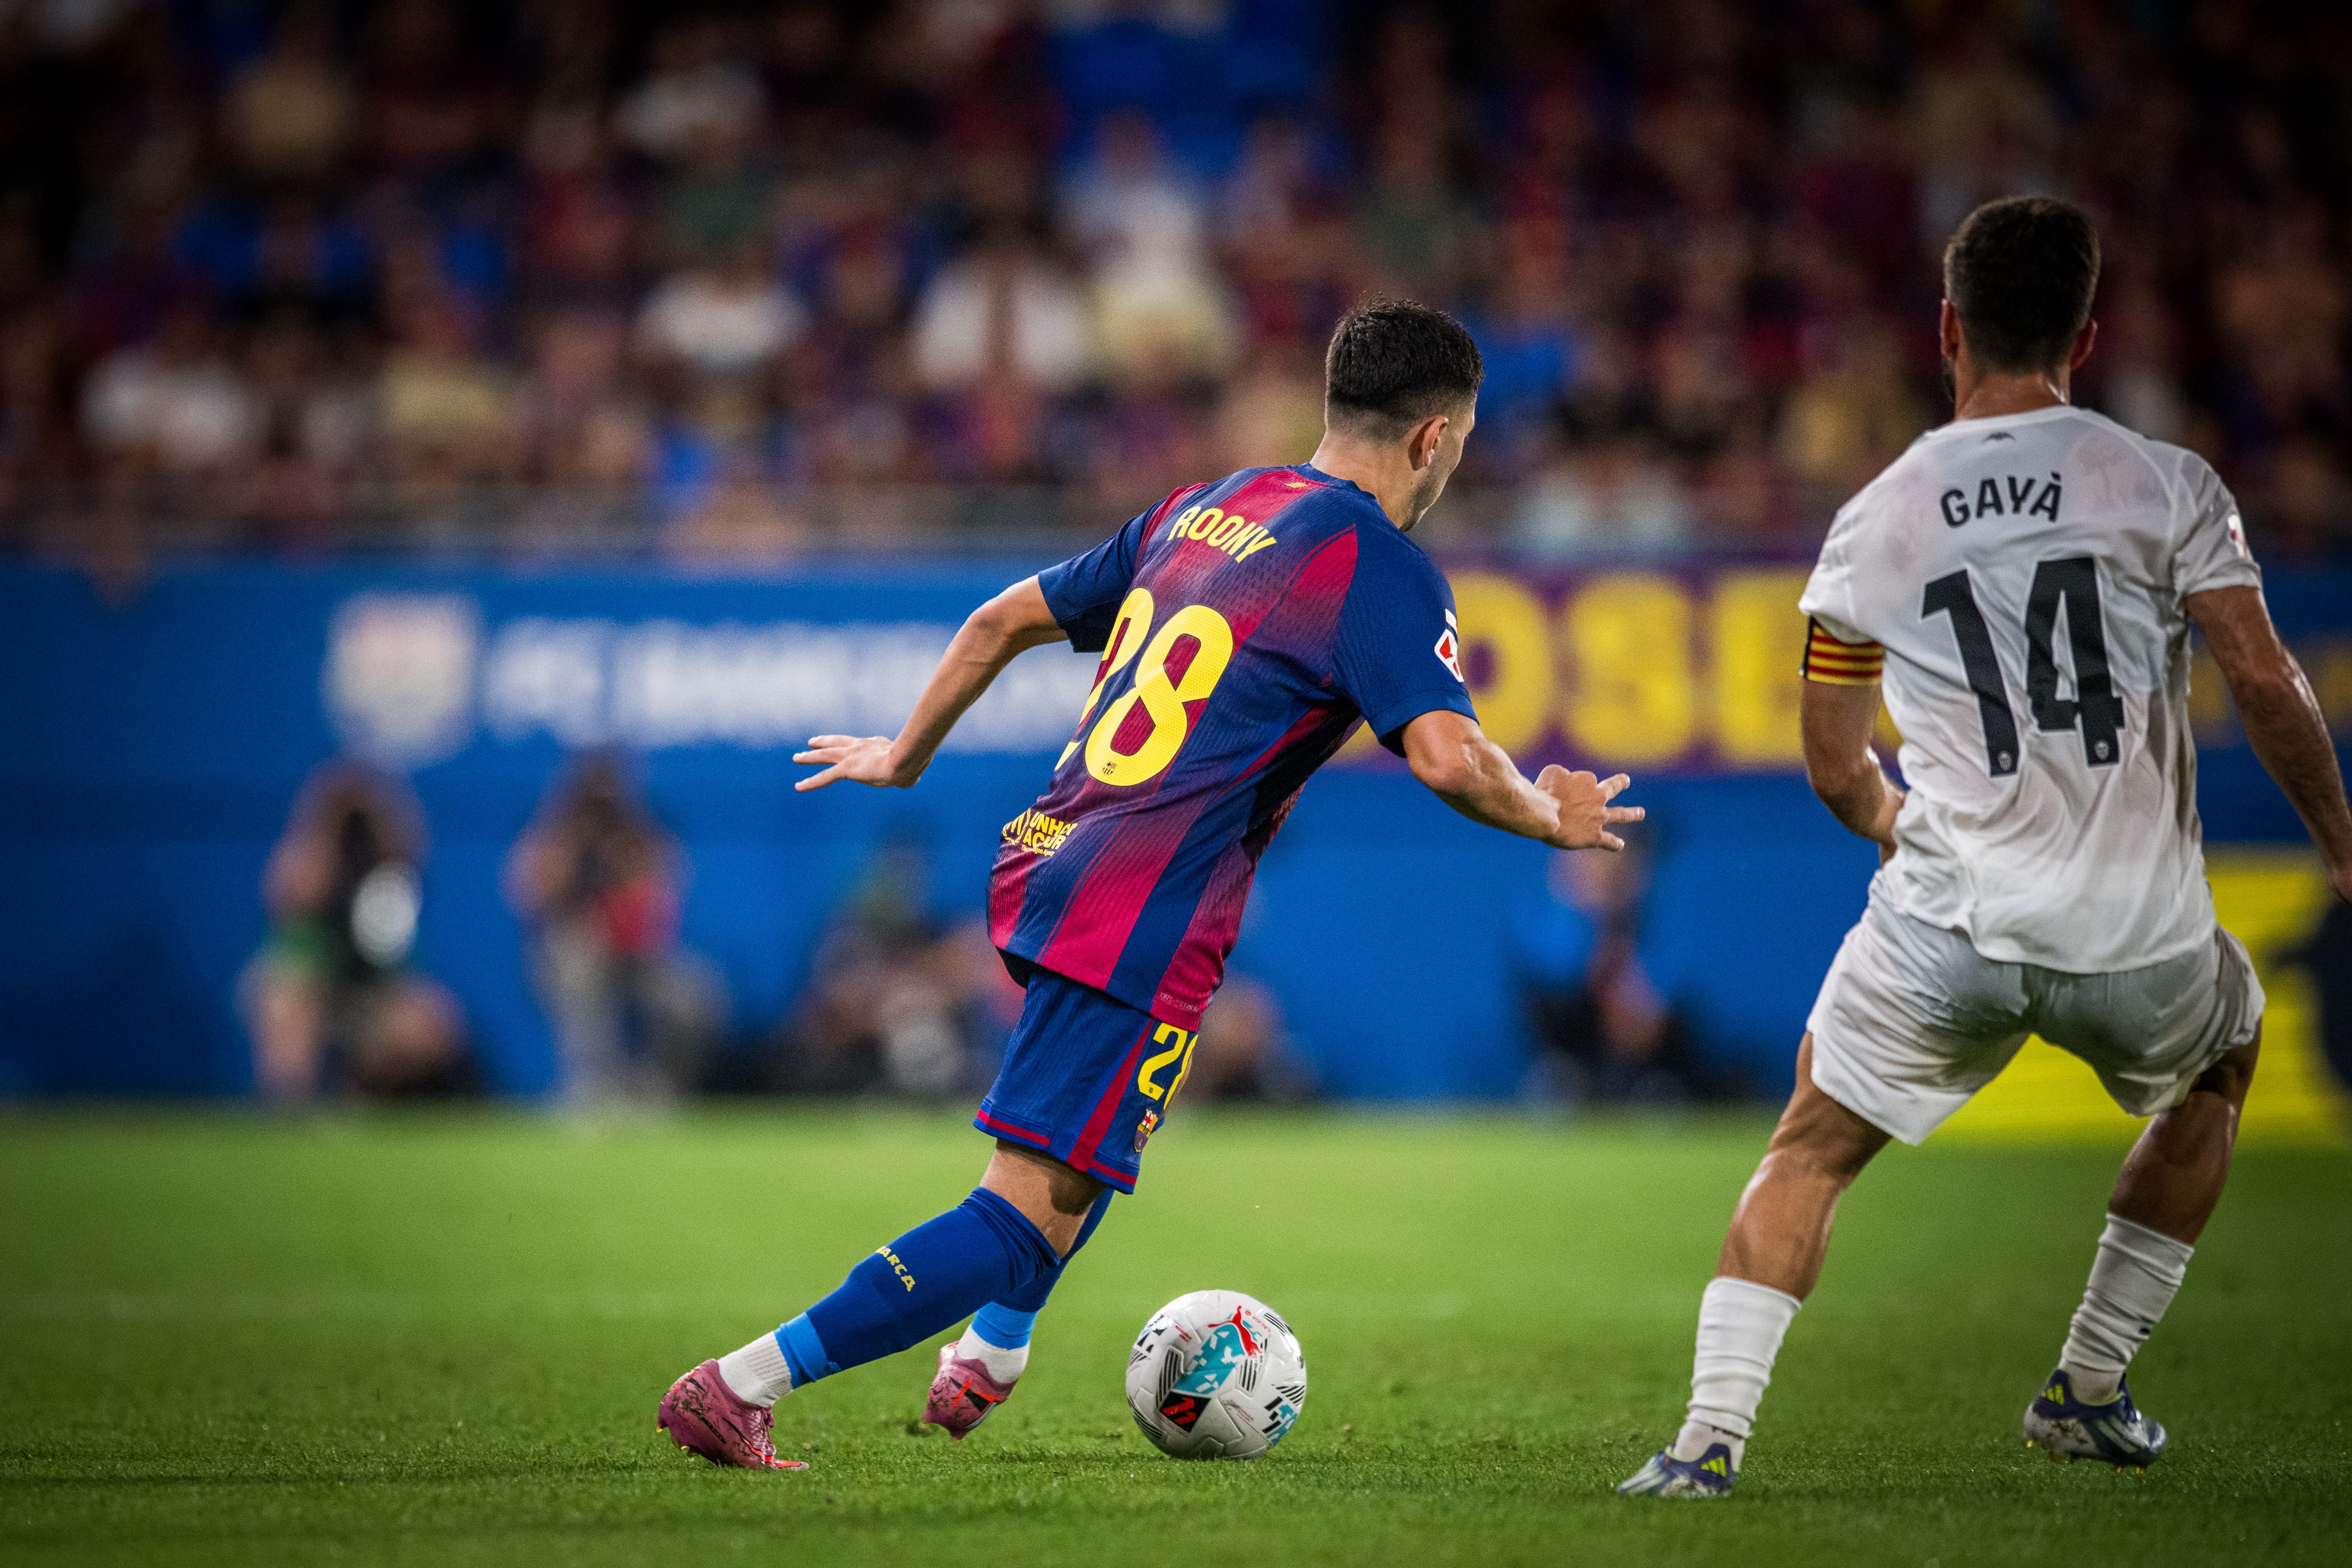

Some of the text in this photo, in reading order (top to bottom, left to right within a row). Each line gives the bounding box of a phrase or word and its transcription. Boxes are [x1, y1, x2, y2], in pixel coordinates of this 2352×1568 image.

[1941, 473, 2062, 528] GAYÀ
[1167, 506, 1277, 563] ROONY
[1054, 587, 1233, 786] 28
[1921, 557, 2125, 777] 14
[1023, 828, 1066, 850] ACUR
